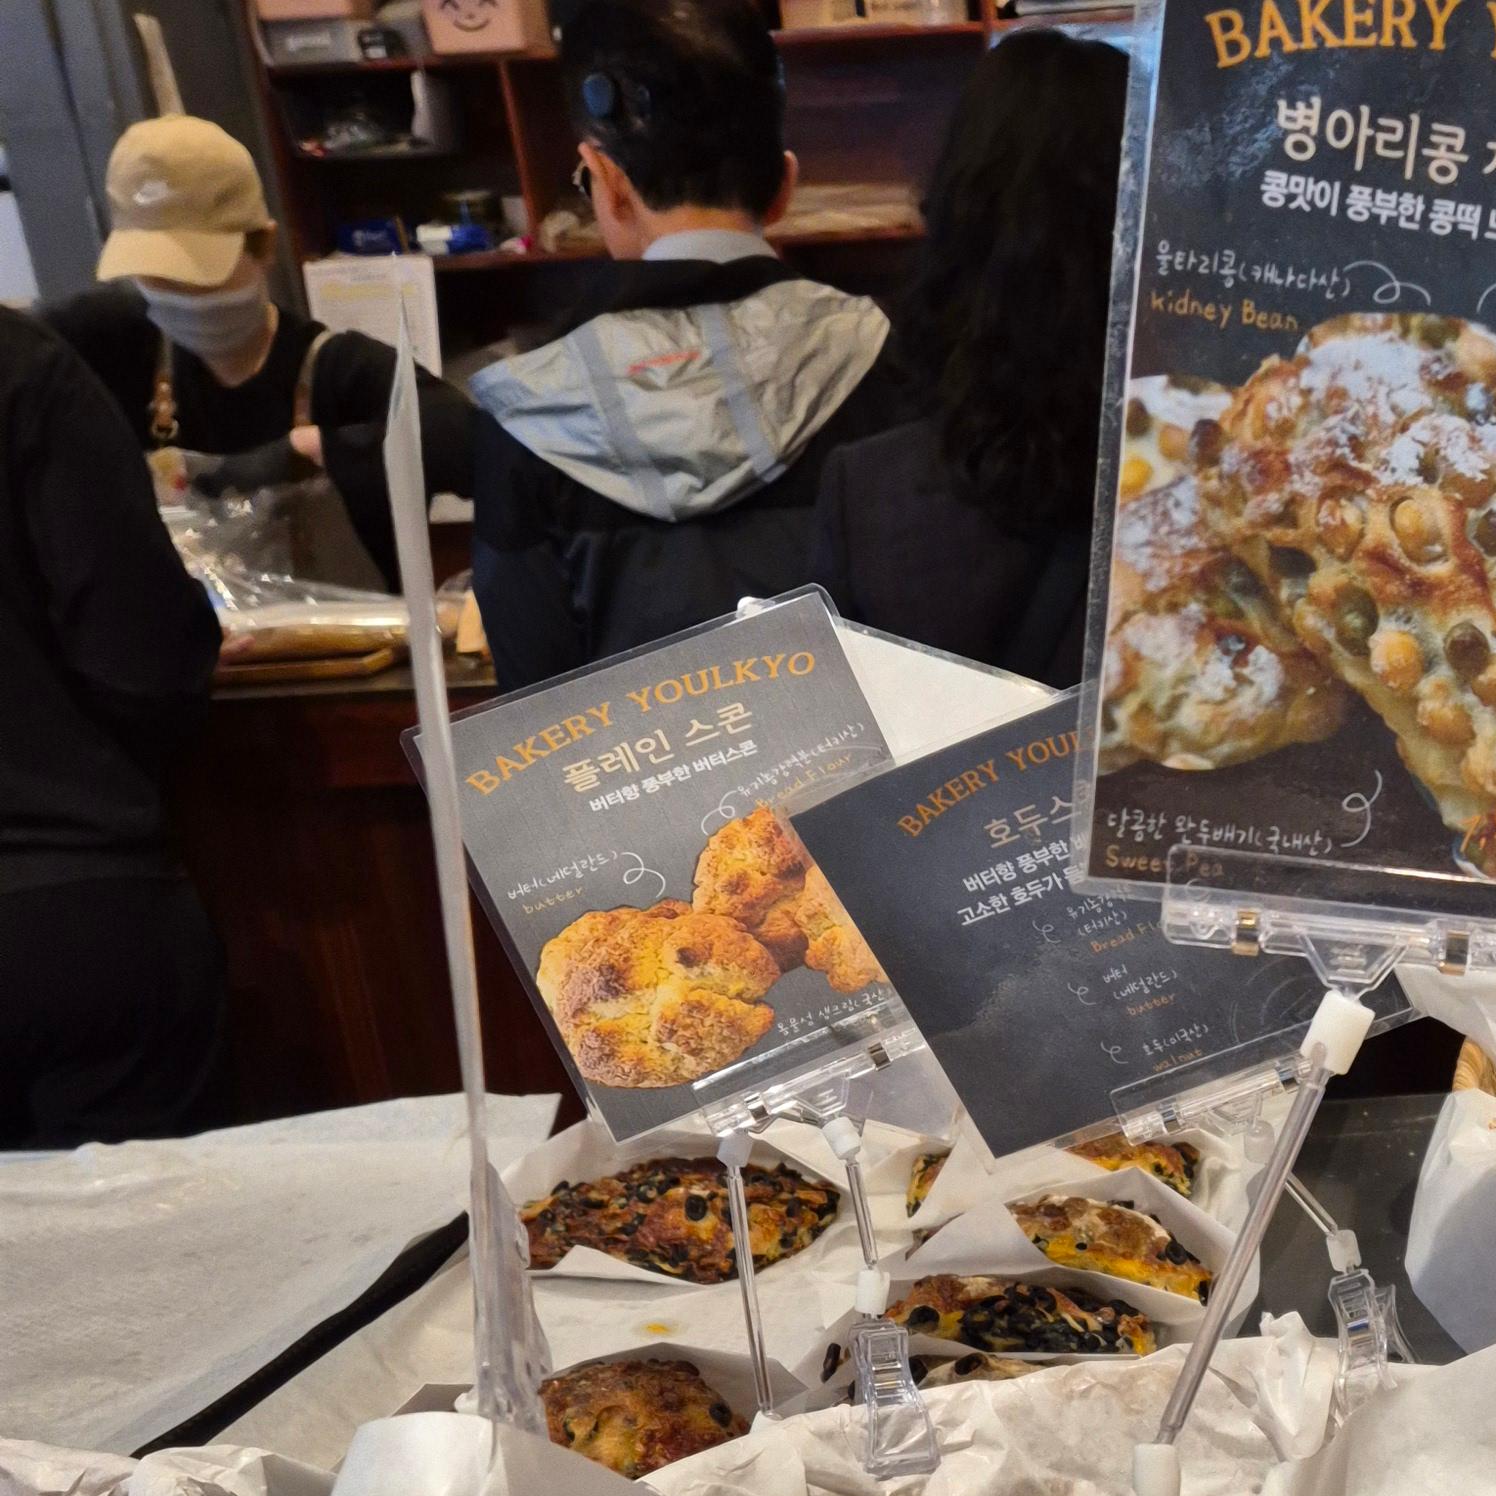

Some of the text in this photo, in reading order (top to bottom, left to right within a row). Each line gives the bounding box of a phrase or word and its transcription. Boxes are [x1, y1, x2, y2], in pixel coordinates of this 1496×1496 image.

[1204, 0, 1462, 69] BAKERY
[1276, 95, 1470, 185] 병아리콩
[1260, 169, 1341, 216] 콩맛이
[1345, 184, 1425, 230] 풍부한
[1429, 198, 1482, 240] 콩떡
[1241, 299, 1298, 331] Bean
[465, 651, 815, 796] BAKERY YOULKYO
[562, 702, 753, 793] 플레인 스콘
[589, 739, 758, 812] 버터향 풍부한 버터스콘
[897, 726, 1092, 837] BAKERY YOUL
[957, 893, 1011, 926] 고소한
[1010, 872, 1064, 906] 호두가
[963, 860, 1017, 892] 버터향
[1016, 839, 1071, 874] 풍부한
